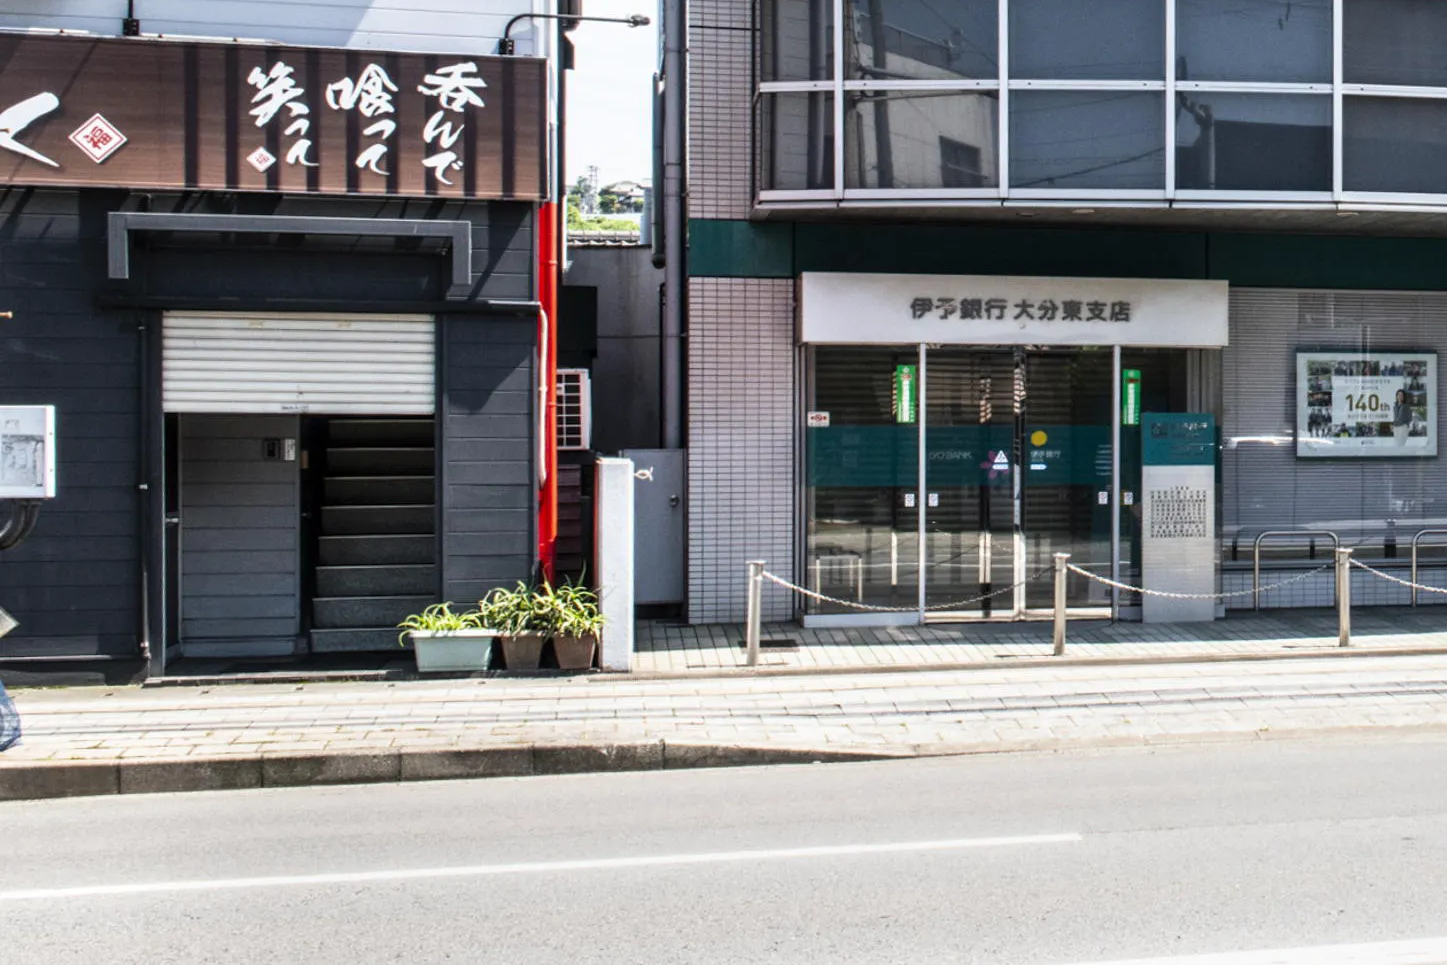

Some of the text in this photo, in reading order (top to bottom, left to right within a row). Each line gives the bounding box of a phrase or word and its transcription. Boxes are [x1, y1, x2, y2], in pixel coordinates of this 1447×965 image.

[247, 61, 319, 167] 笑って
[326, 63, 398, 175] 喰って
[417, 62, 487, 185] 呑んで
[910, 298, 1131, 322] 伊予銀行 大分東支店
[1345, 394, 1390, 412] 140th
